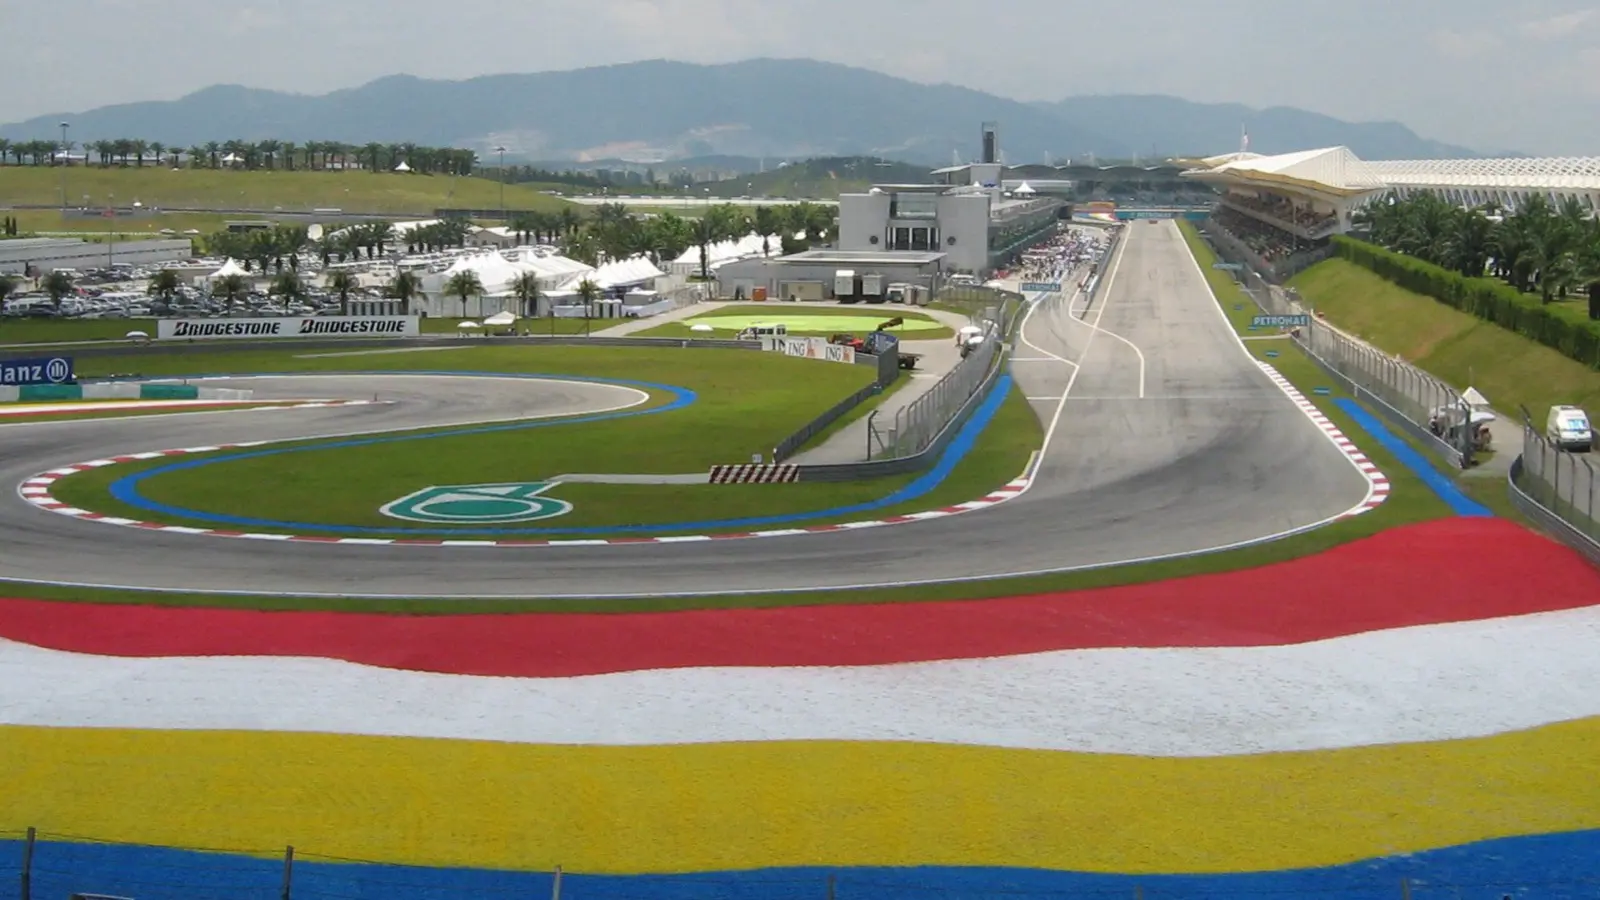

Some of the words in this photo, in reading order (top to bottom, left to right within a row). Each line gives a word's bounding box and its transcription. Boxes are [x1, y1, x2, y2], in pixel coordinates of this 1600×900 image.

[173, 321, 281, 336] BRIDGESTONE
[299, 318, 406, 334] BRIDGESTONE
[788, 342, 805, 356] ING
